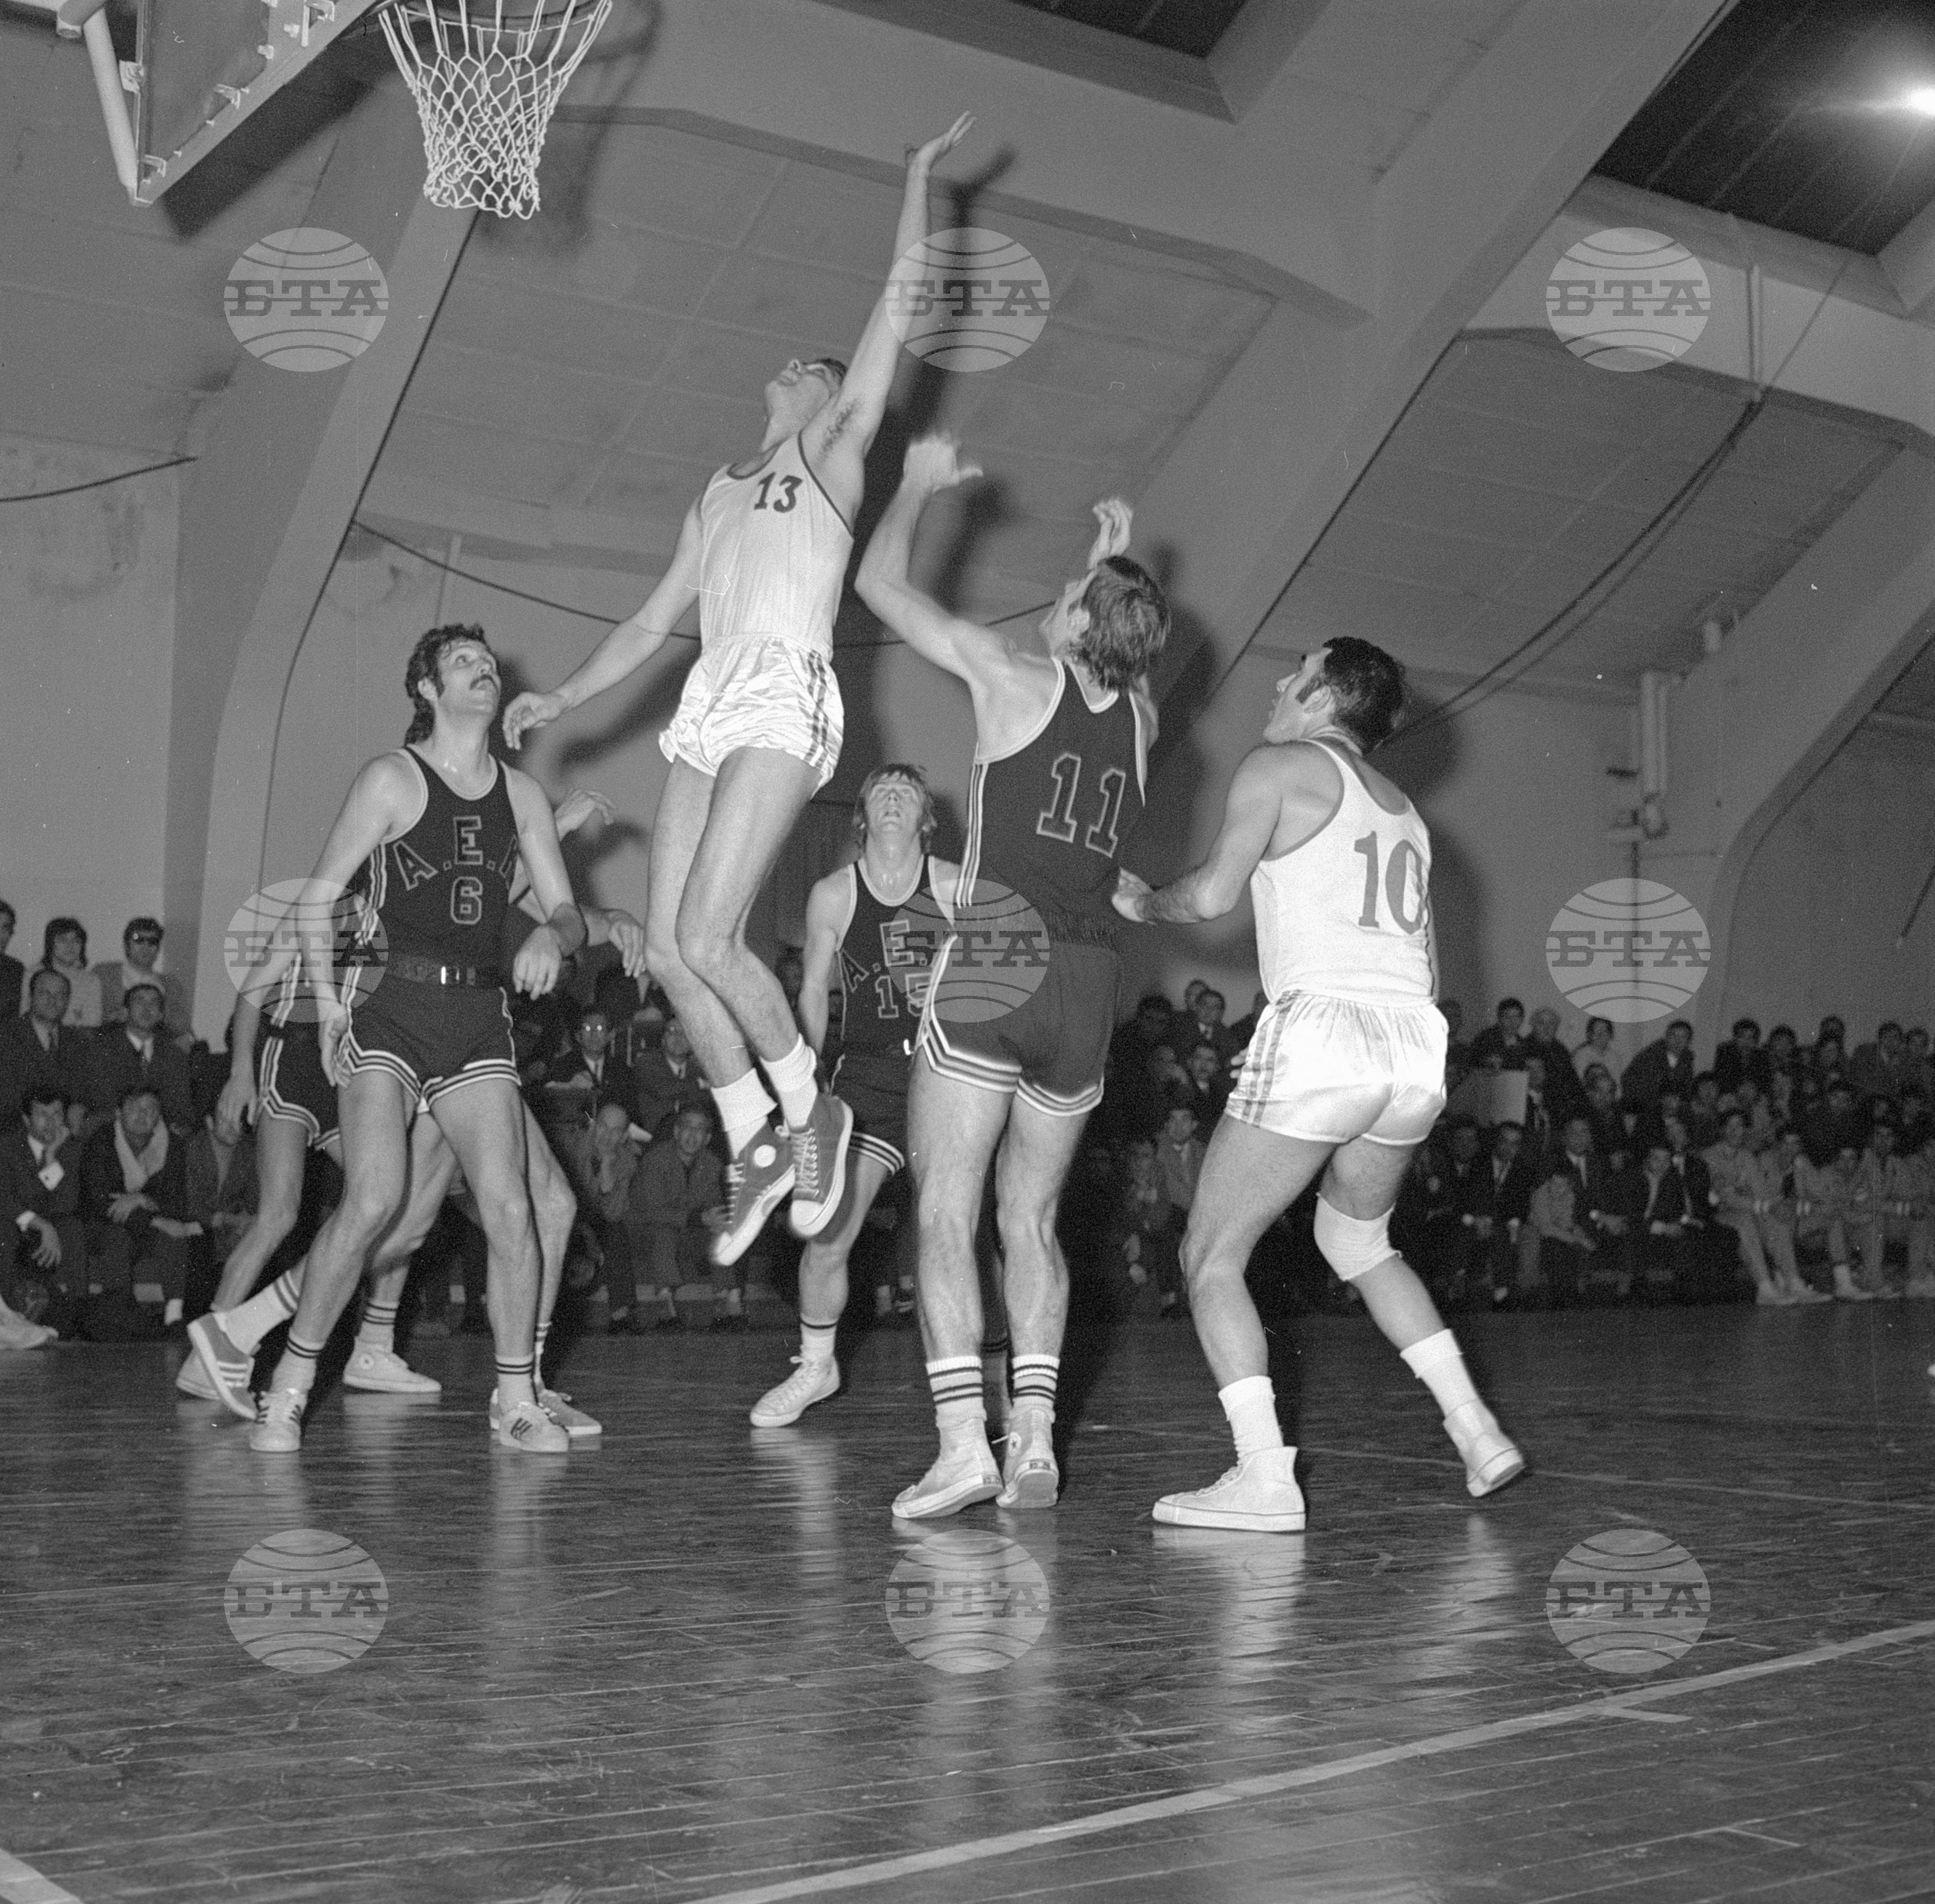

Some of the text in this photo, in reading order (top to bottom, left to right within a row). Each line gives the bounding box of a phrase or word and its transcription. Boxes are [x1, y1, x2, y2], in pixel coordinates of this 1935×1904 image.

[754, 472, 802, 512] 13
[1036, 752, 1125, 857] 11
[451, 876, 482, 925] 6
[1354, 830, 1422, 934] 10
